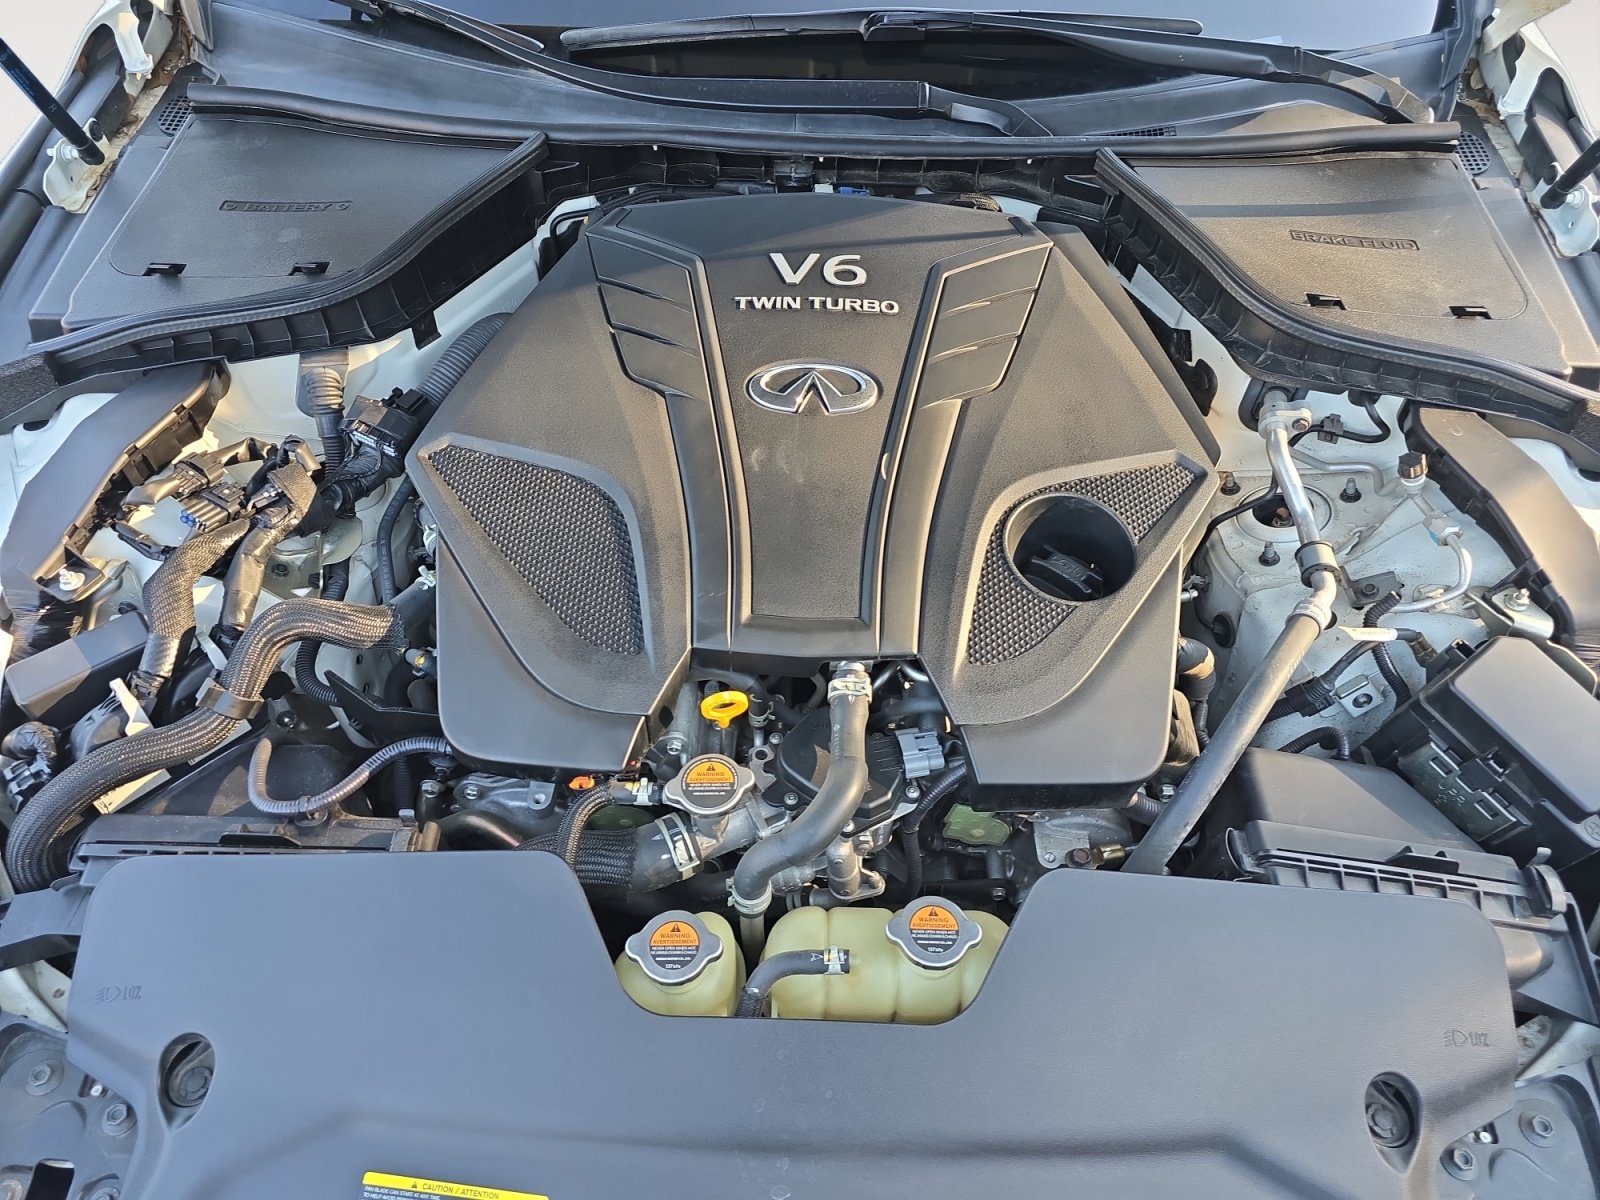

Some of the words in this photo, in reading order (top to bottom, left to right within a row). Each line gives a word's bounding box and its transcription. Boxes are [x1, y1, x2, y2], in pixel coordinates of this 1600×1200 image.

[244, 202, 333, 212] BATTERY
[1290, 231, 1358, 248] BRAKE
[1360, 238, 1418, 251] FLUID
[769, 252, 867, 287] V6
[734, 296, 801, 311] TWIN
[808, 296, 899, 315] TURBO
[422, 1183, 454, 1193] CAUTION
[460, 1188, 500, 1199] ATTENTION
